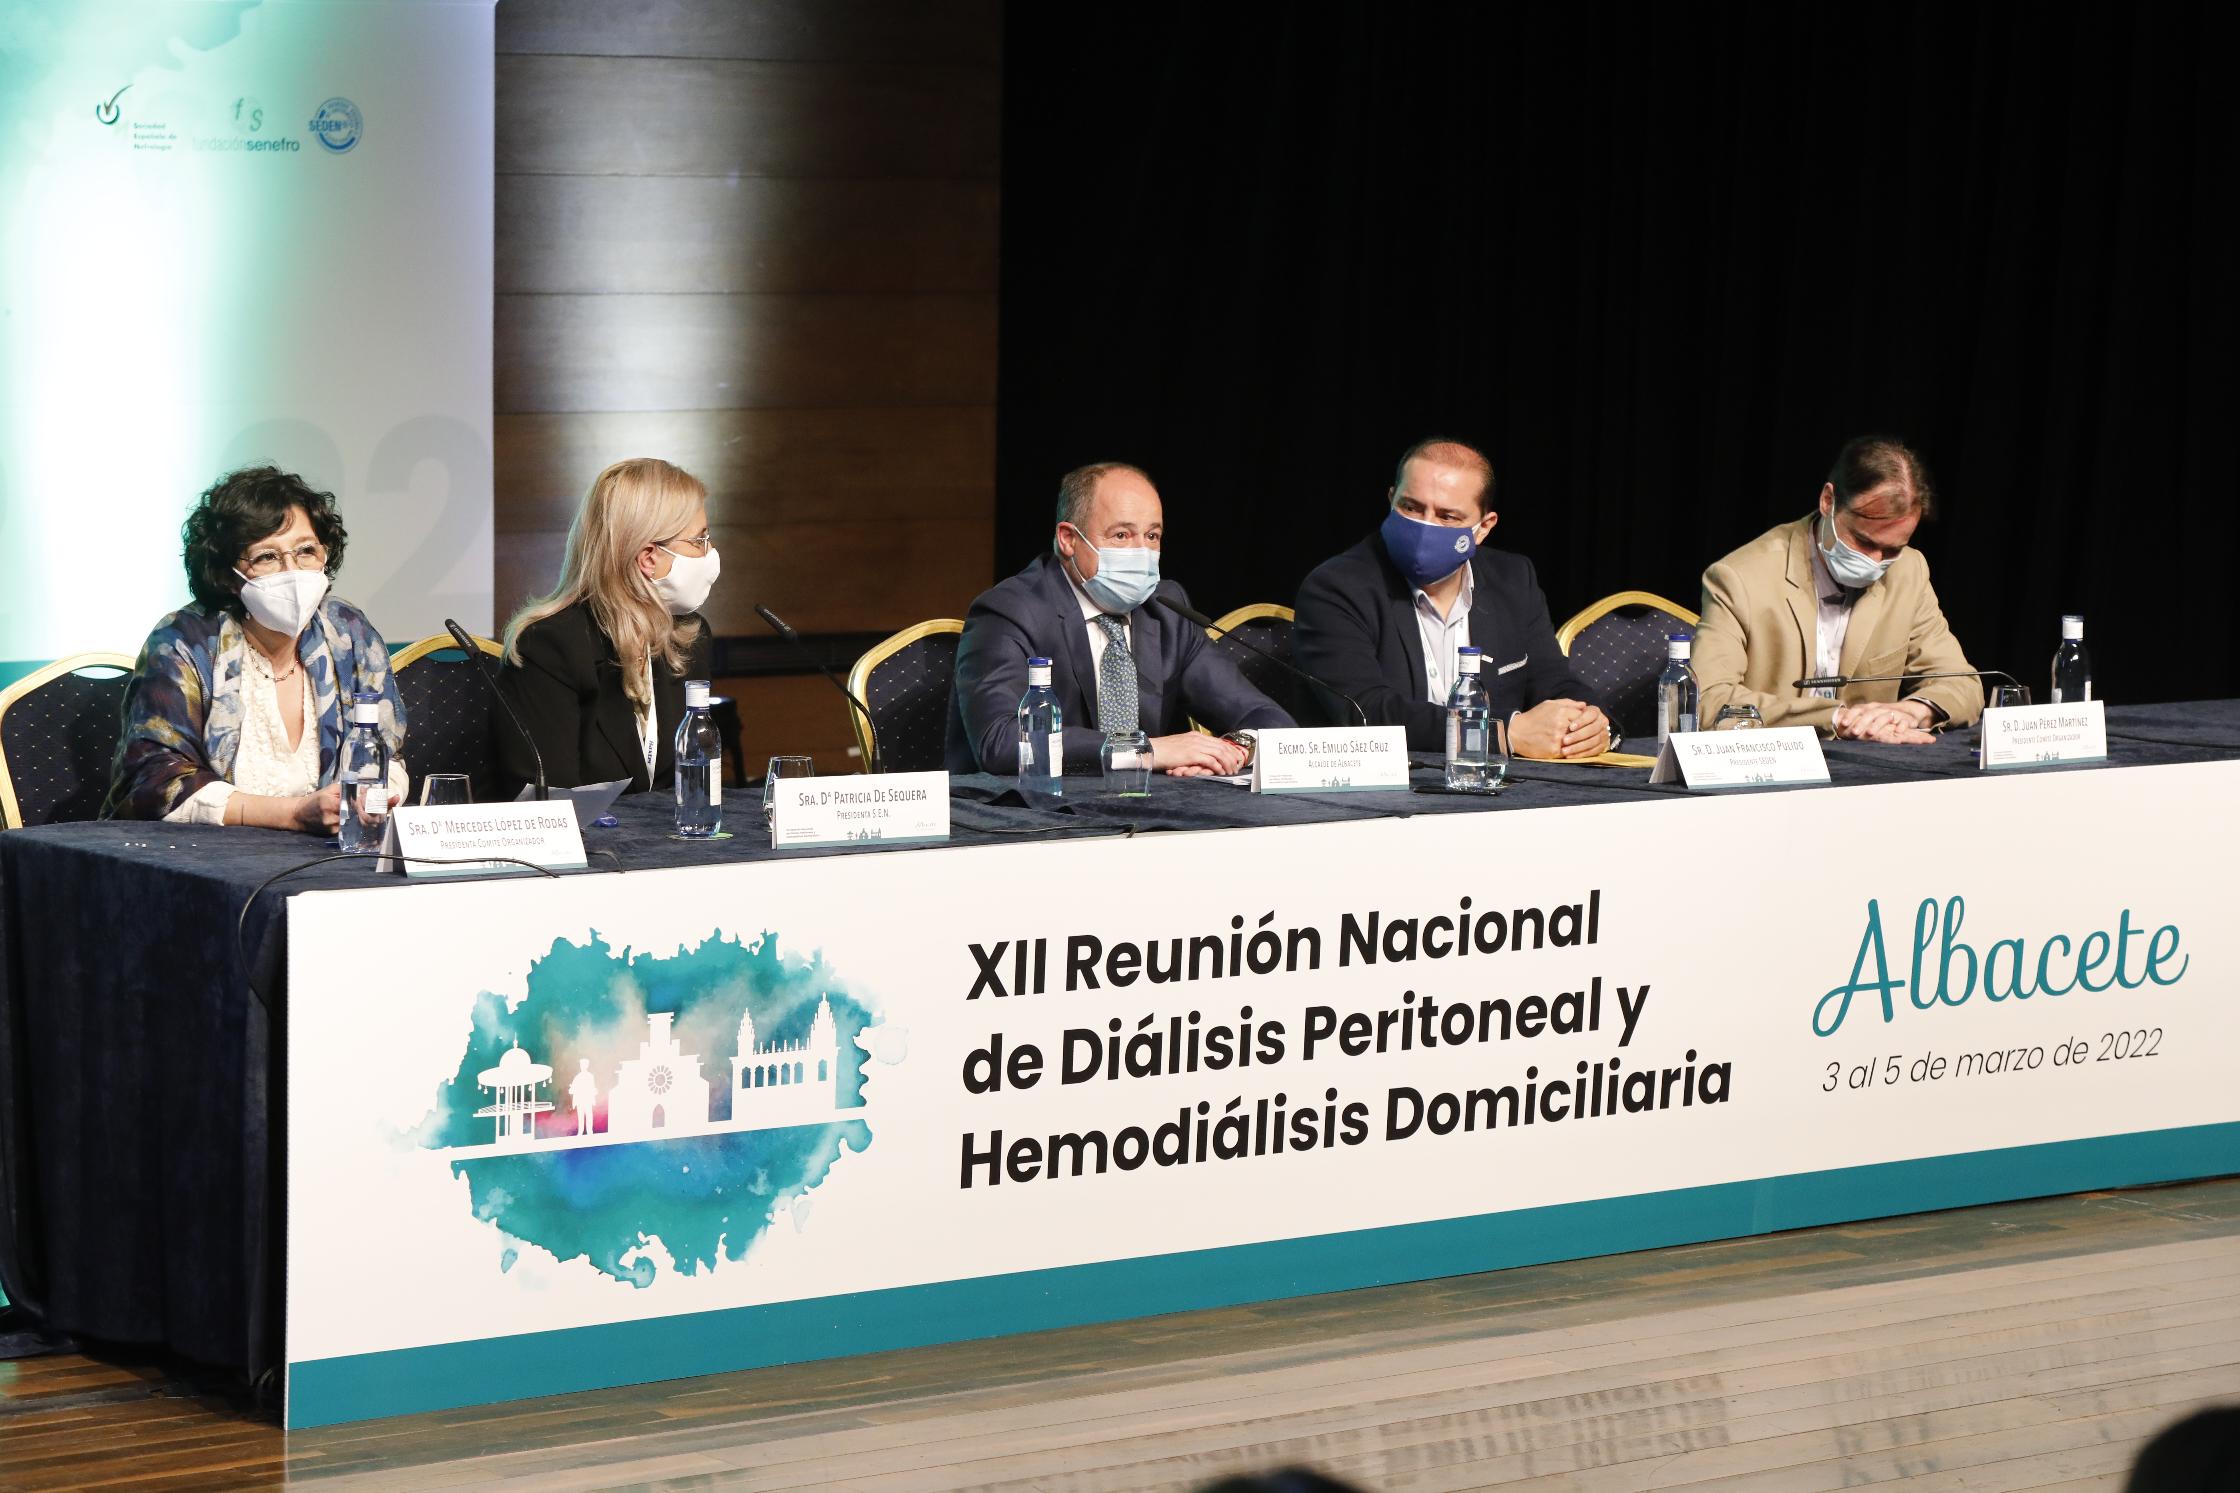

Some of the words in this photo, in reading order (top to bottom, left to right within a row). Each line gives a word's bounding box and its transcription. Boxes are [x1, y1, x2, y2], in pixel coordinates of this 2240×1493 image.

[445, 819, 494, 834] MERCEDES
[537, 816, 568, 829] RODAS
[834, 791, 872, 804] PATRICIA
[888, 788, 927, 802] SEQUERA
[966, 938, 1046, 1000] XII
[1066, 910, 1321, 991] Reunión
[1339, 890, 1600, 967] Nacional
[1813, 896, 2188, 1037] Albacete
[963, 1033, 1043, 1094] de
[1062, 1006, 1285, 1085] Diálisis
[1303, 977, 1602, 1060] Peritoneal
[1617, 985, 1650, 1047] y
[1823, 1062, 1840, 1091] 3
[1849, 1057, 1876, 1089] al
[1885, 1055, 1902, 1085] 5
[1911, 1051, 1946, 1082] de
[1956, 1047, 2043, 1077] marzo
[2054, 1036, 2088, 1066] de
[2097, 1028, 2162, 1061] 2022
[961, 1088, 1369, 1189] Hemodiálisis
[1386, 1049, 1731, 1141] Domiciliaria
